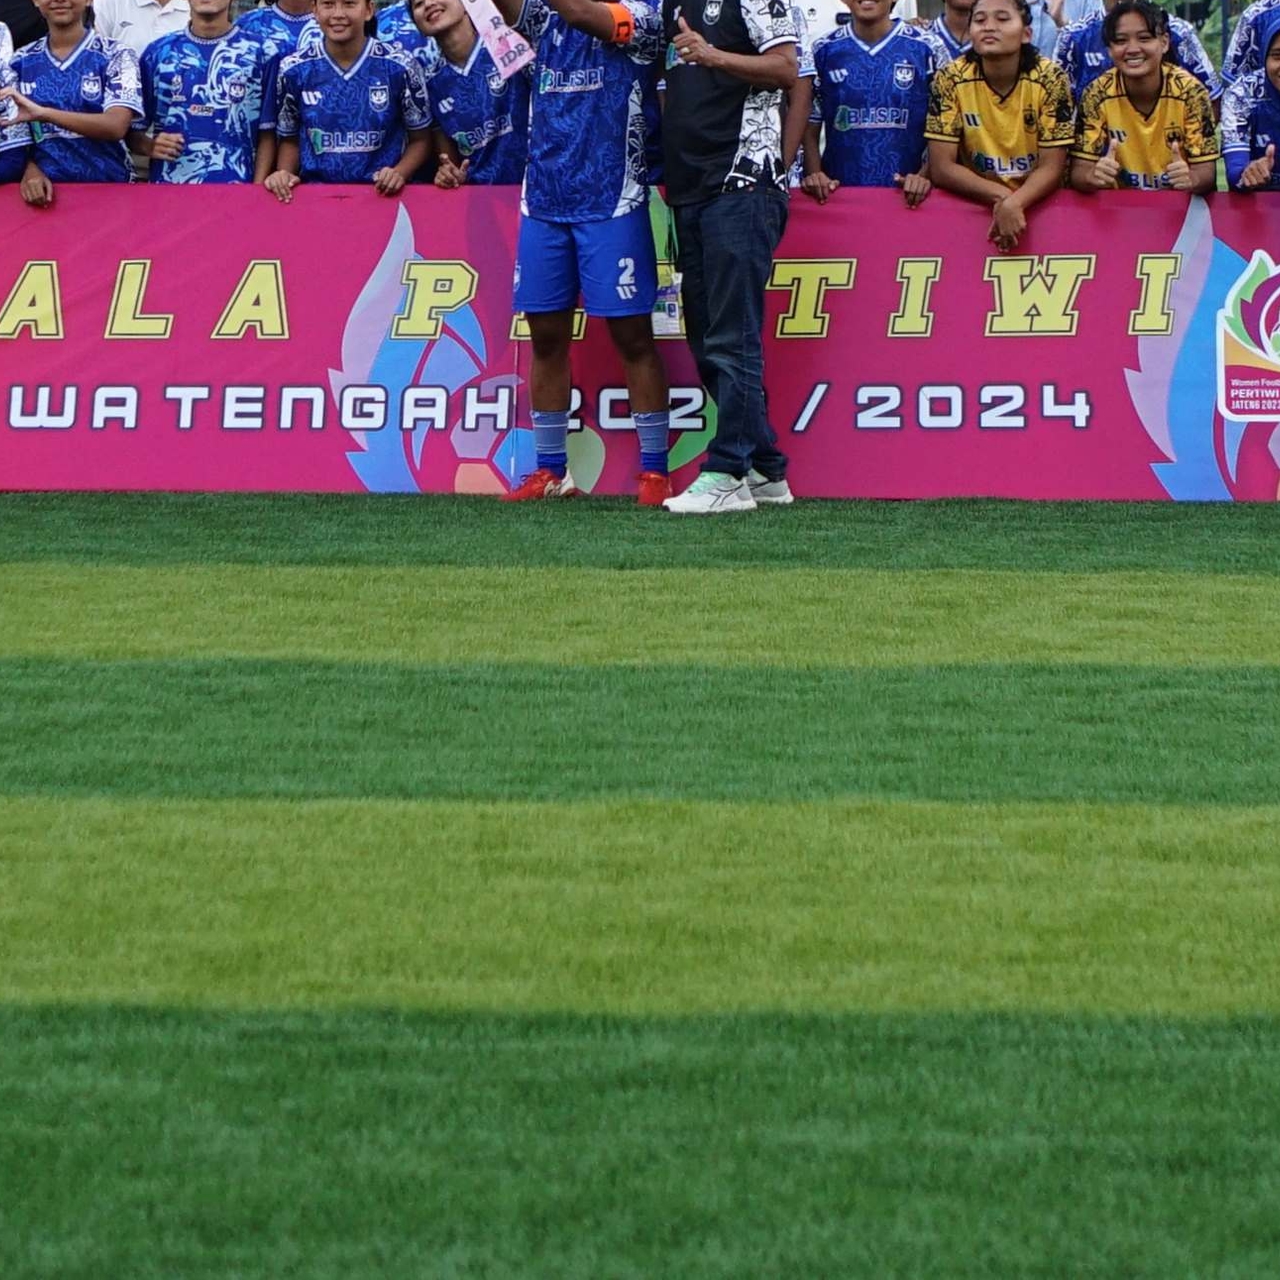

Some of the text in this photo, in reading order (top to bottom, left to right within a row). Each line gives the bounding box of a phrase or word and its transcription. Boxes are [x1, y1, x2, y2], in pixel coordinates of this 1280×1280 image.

[618, 257, 635, 285] 2
[390, 252, 1184, 341] PTIWI
[165, 384, 512, 430] TENGAH
[1230, 388, 1280, 398] PERTIWI
